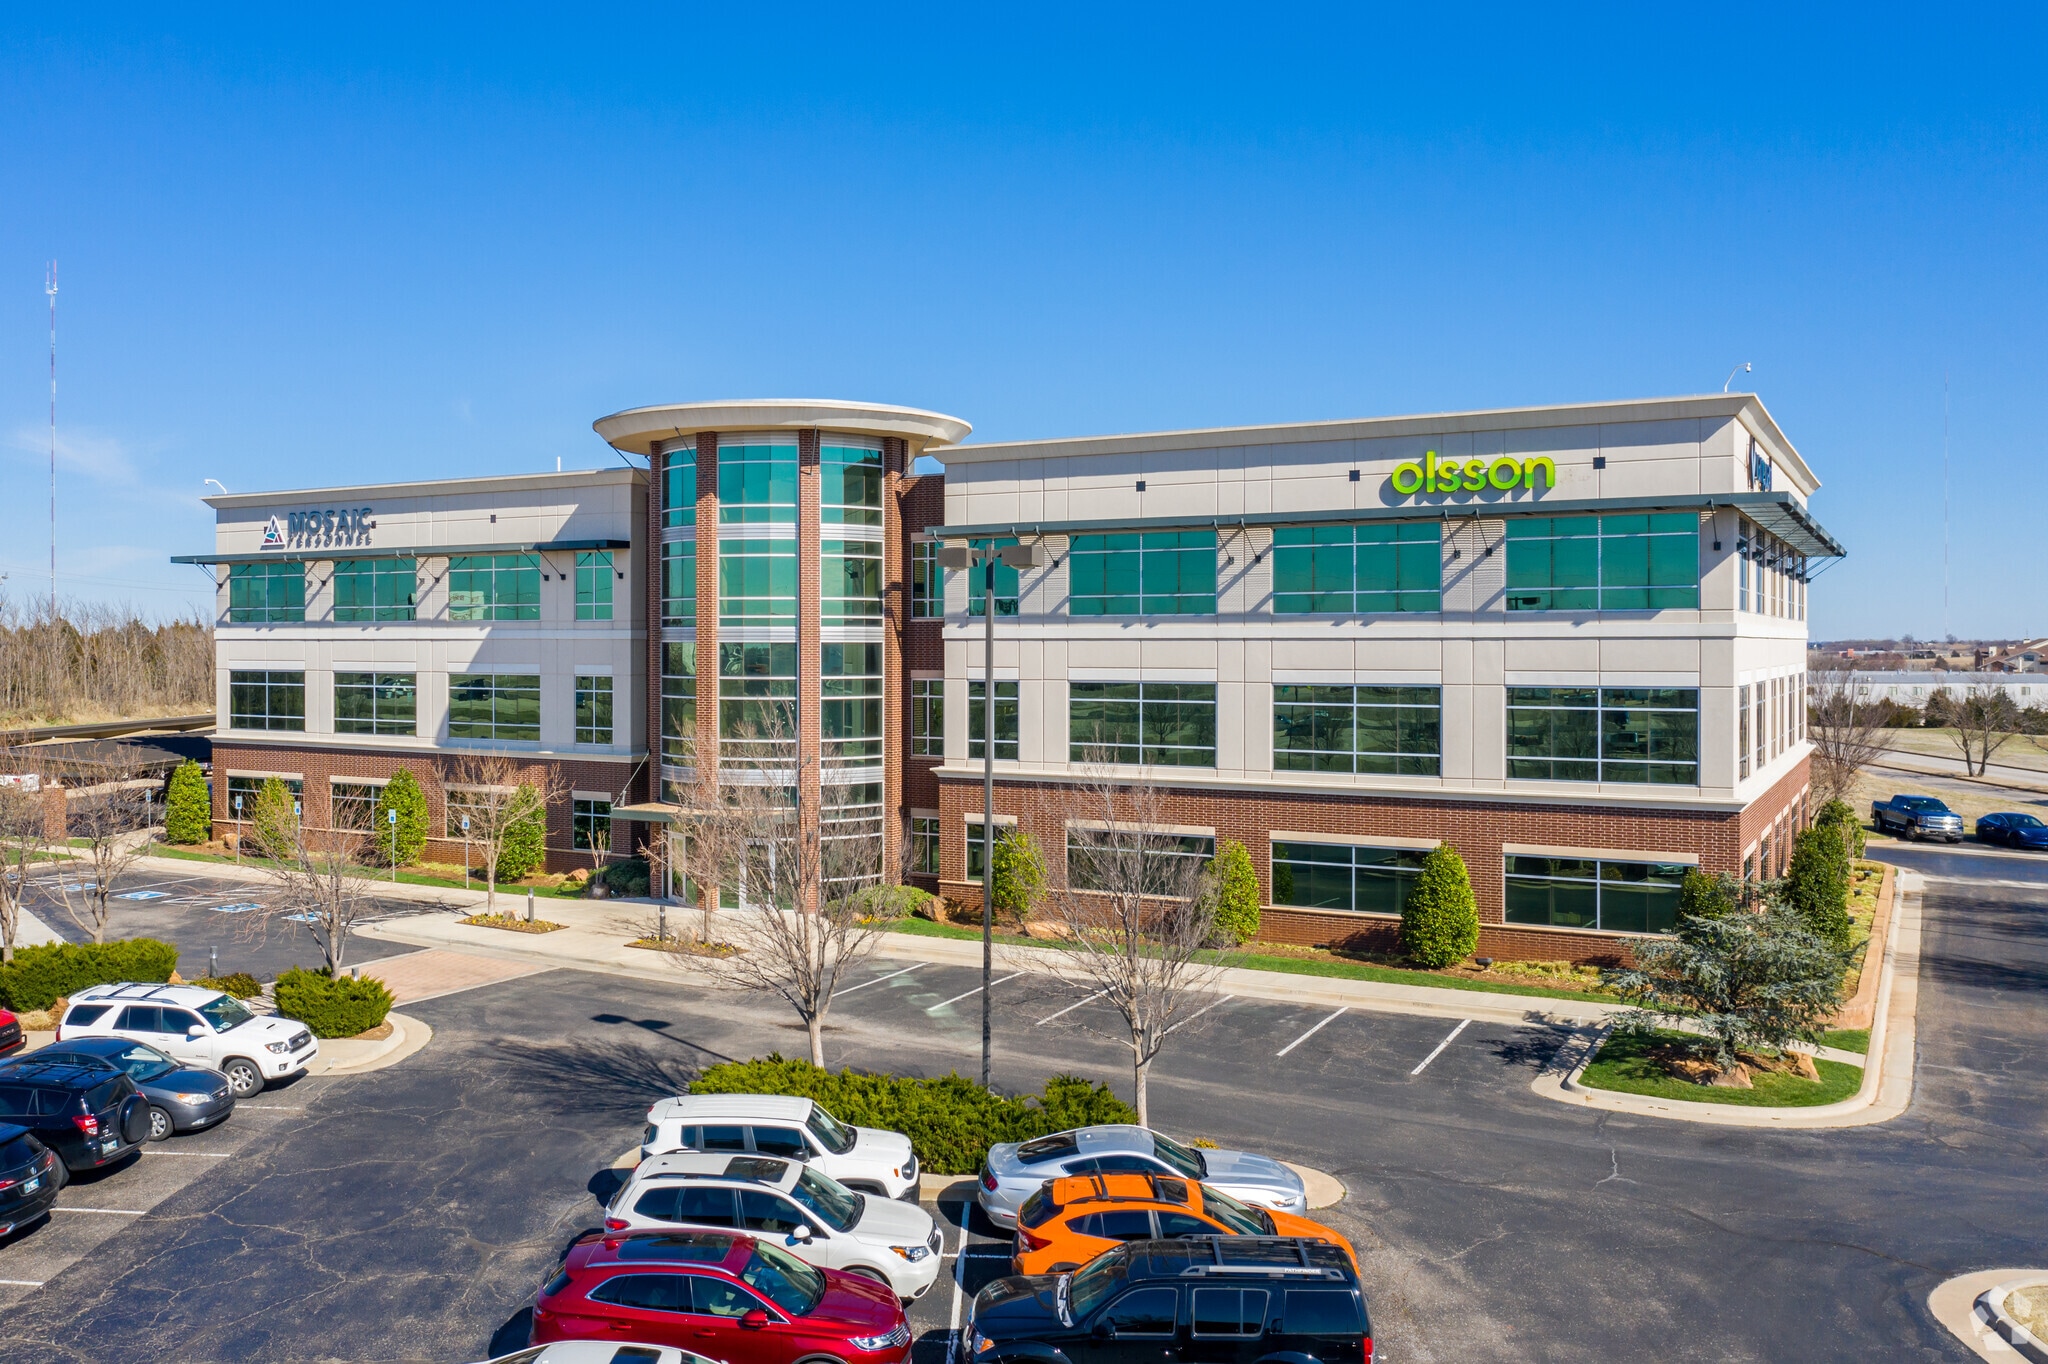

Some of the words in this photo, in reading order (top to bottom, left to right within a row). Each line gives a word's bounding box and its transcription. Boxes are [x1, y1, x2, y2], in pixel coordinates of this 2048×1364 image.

[1392, 451, 1555, 494] olsson
[288, 508, 372, 535] MOSAIC
[287, 533, 372, 549] PERSONNEL
